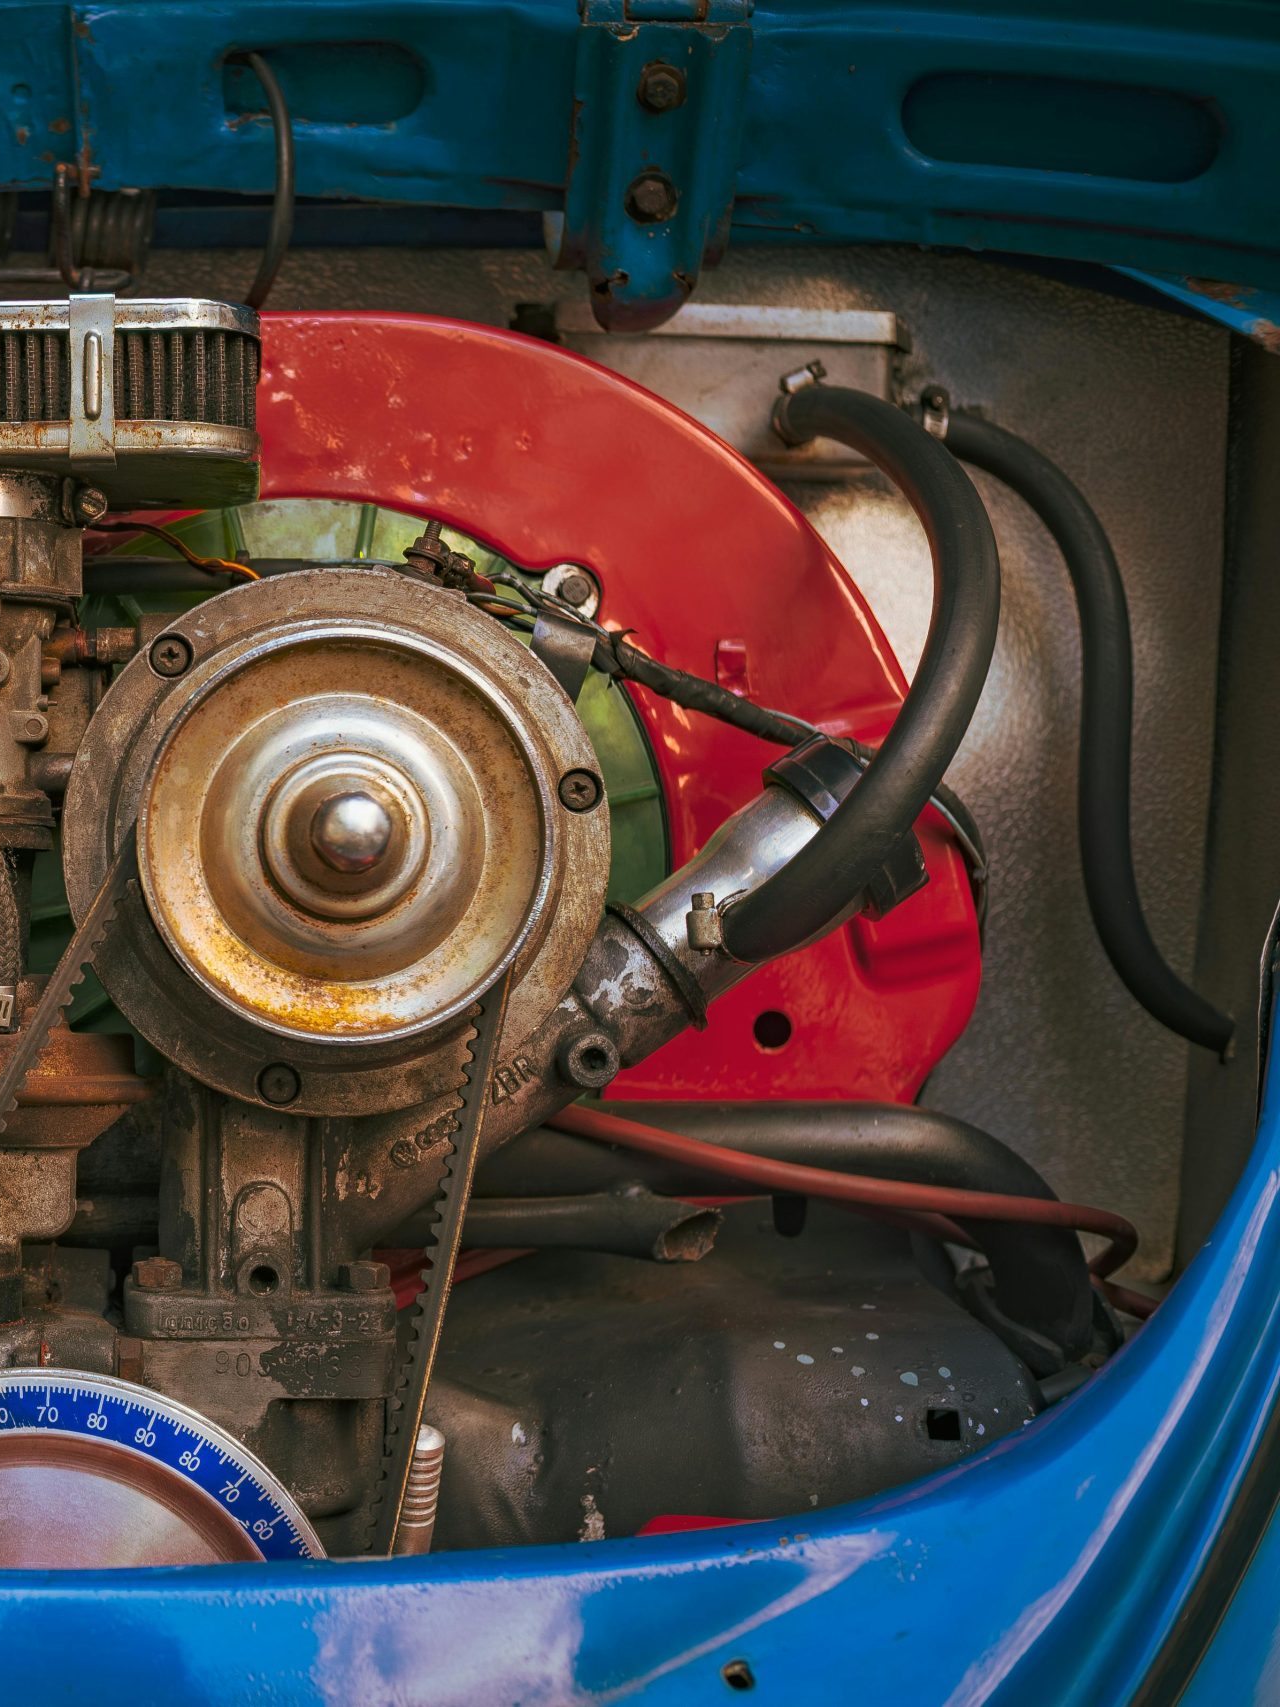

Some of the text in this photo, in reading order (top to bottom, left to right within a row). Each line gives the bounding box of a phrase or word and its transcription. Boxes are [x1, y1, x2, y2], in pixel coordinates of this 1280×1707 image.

[36, 1406, 59, 1423] 70
[86, 1412, 108, 1431] 80
[134, 1427, 156, 1447] 90
[178, 1450, 201, 1472] 80
[218, 1480, 240, 1503] 70
[252, 1518, 274, 1540] 60
